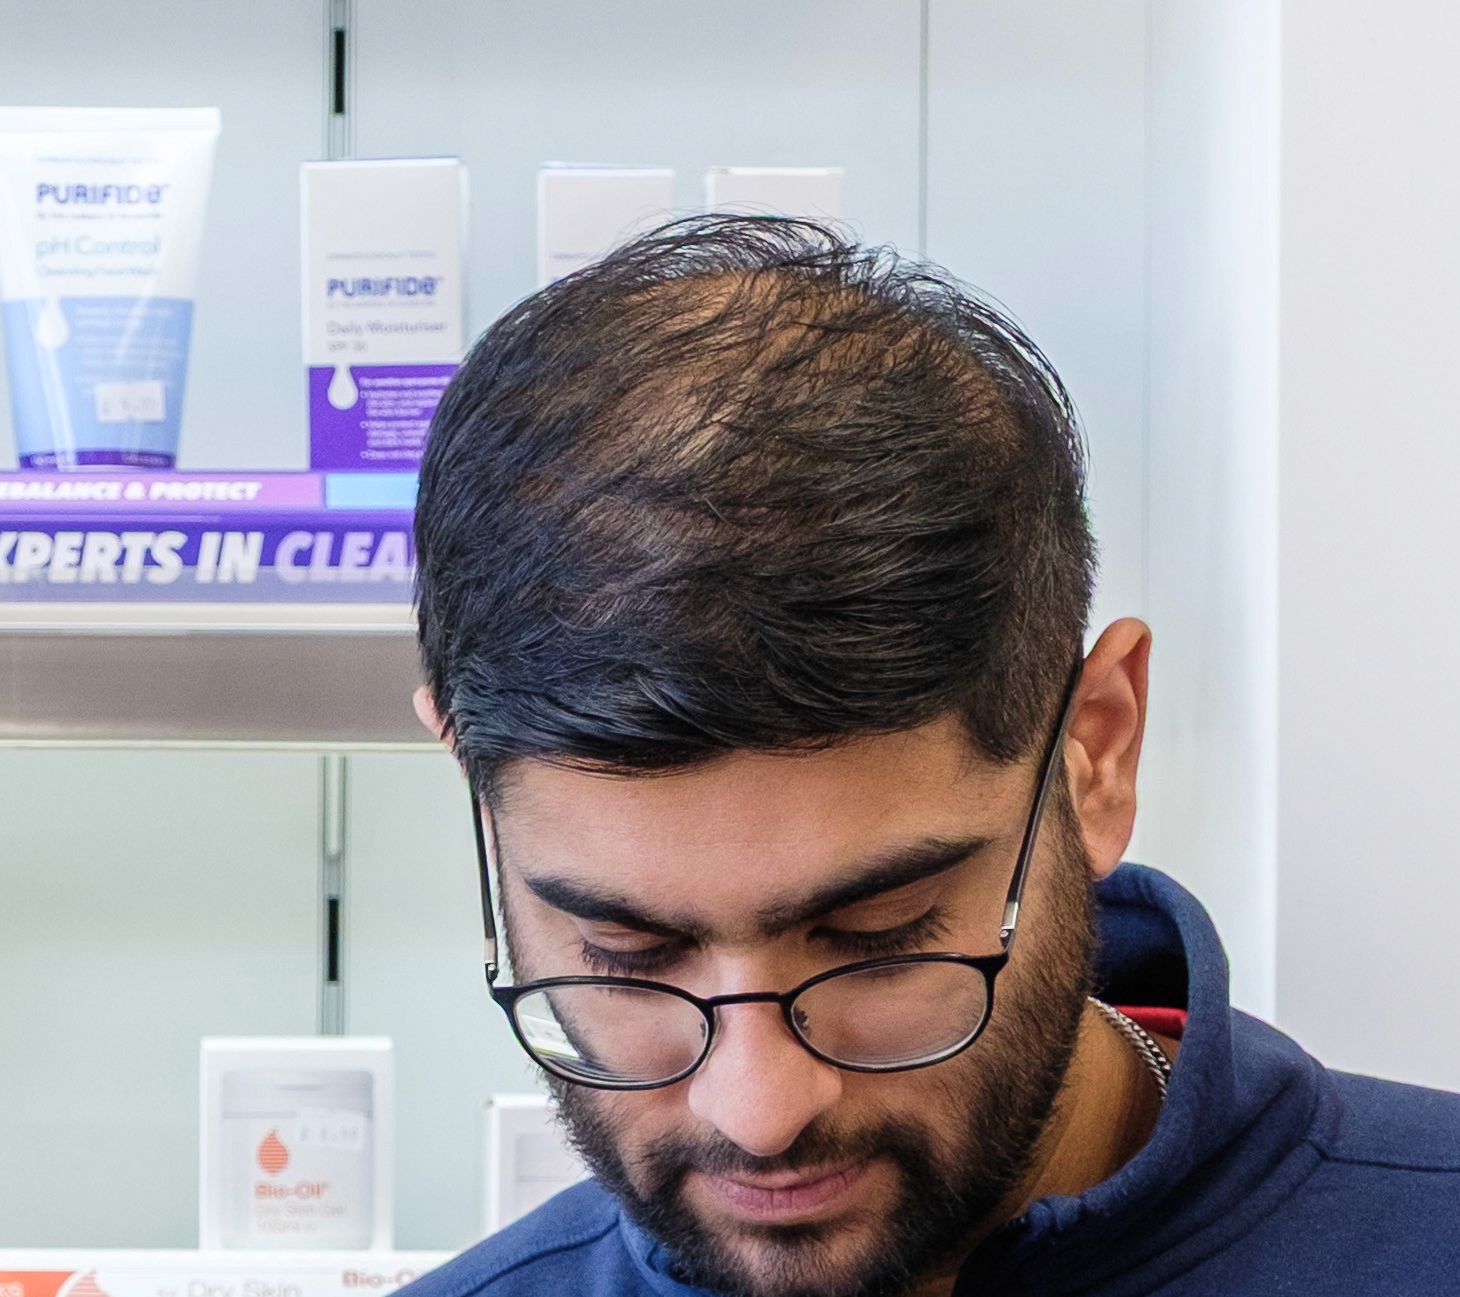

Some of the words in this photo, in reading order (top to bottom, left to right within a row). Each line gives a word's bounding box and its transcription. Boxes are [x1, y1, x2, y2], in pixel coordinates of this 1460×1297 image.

[126, 481, 144, 502] &
[148, 480, 263, 503] PROTECT
[195, 531, 264, 584] IN
[274, 531, 415, 584] CLEA
[341, 1268, 417, 1289] Bio-O
